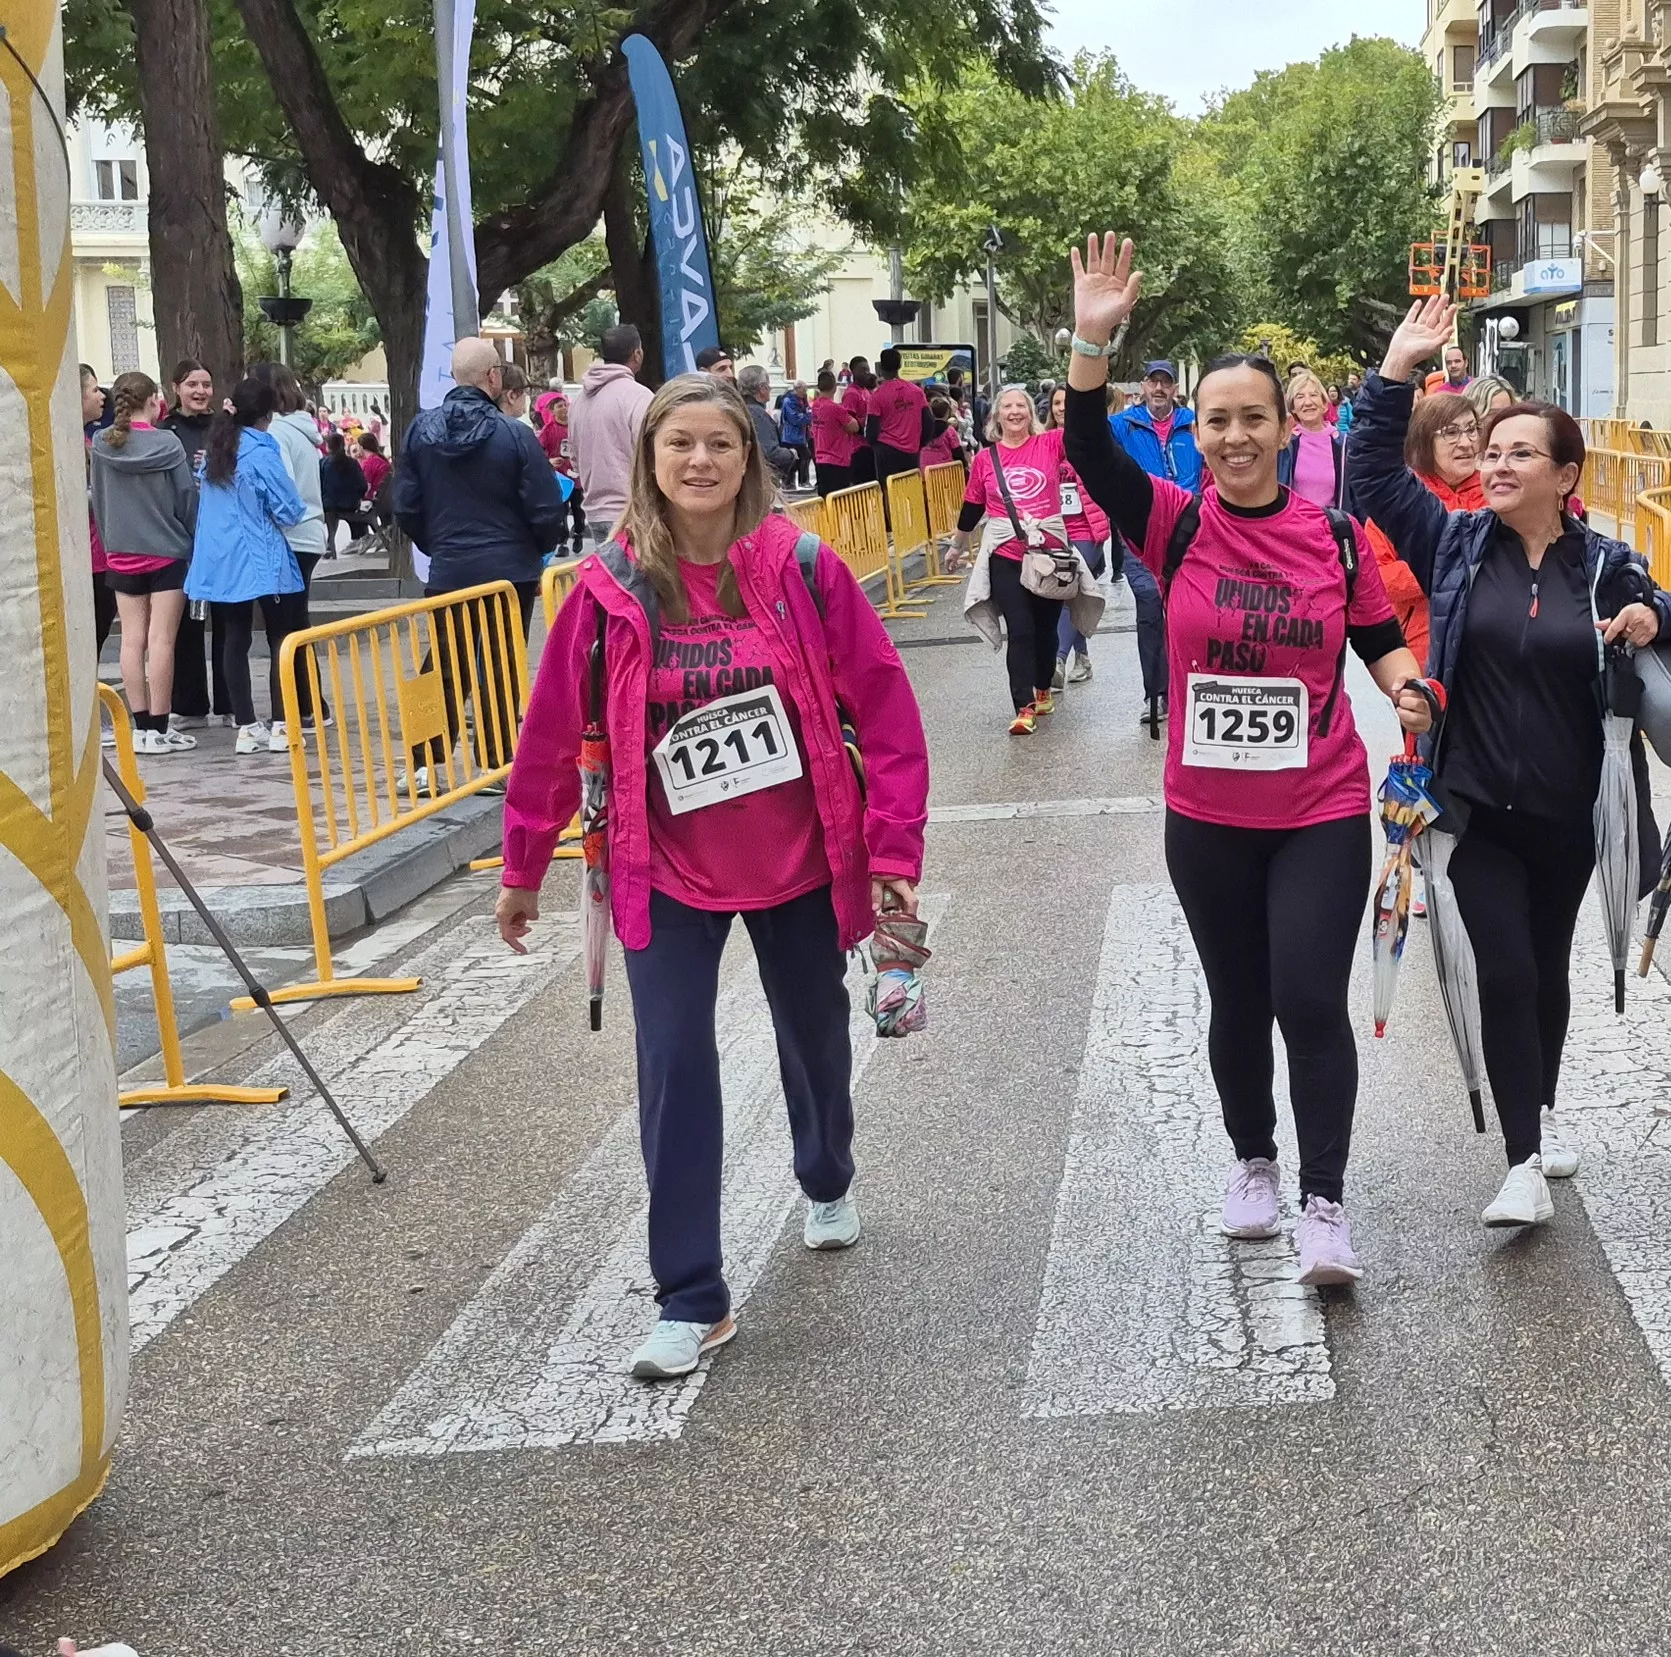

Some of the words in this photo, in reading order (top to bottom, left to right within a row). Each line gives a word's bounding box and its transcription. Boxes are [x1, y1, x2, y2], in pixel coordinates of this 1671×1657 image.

[1215, 577, 1293, 614] UNIDOS
[1241, 612, 1270, 644] EN
[1273, 616, 1325, 650] CADA
[1207, 637, 1268, 673] PASO
[683, 671, 713, 700] EN
[1200, 692, 1239, 704] CONTRA
[1242, 695, 1254, 704] EL
[1255, 693, 1295, 705] CÁNCER
[1232, 687, 1262, 695] HUESCA
[697, 708, 729, 724] HUESCA
[709, 719, 724, 732] EL
[724, 706, 769, 726] CÁNCER
[1199, 707, 1295, 743] 1259
[671, 721, 778, 781] 1211
